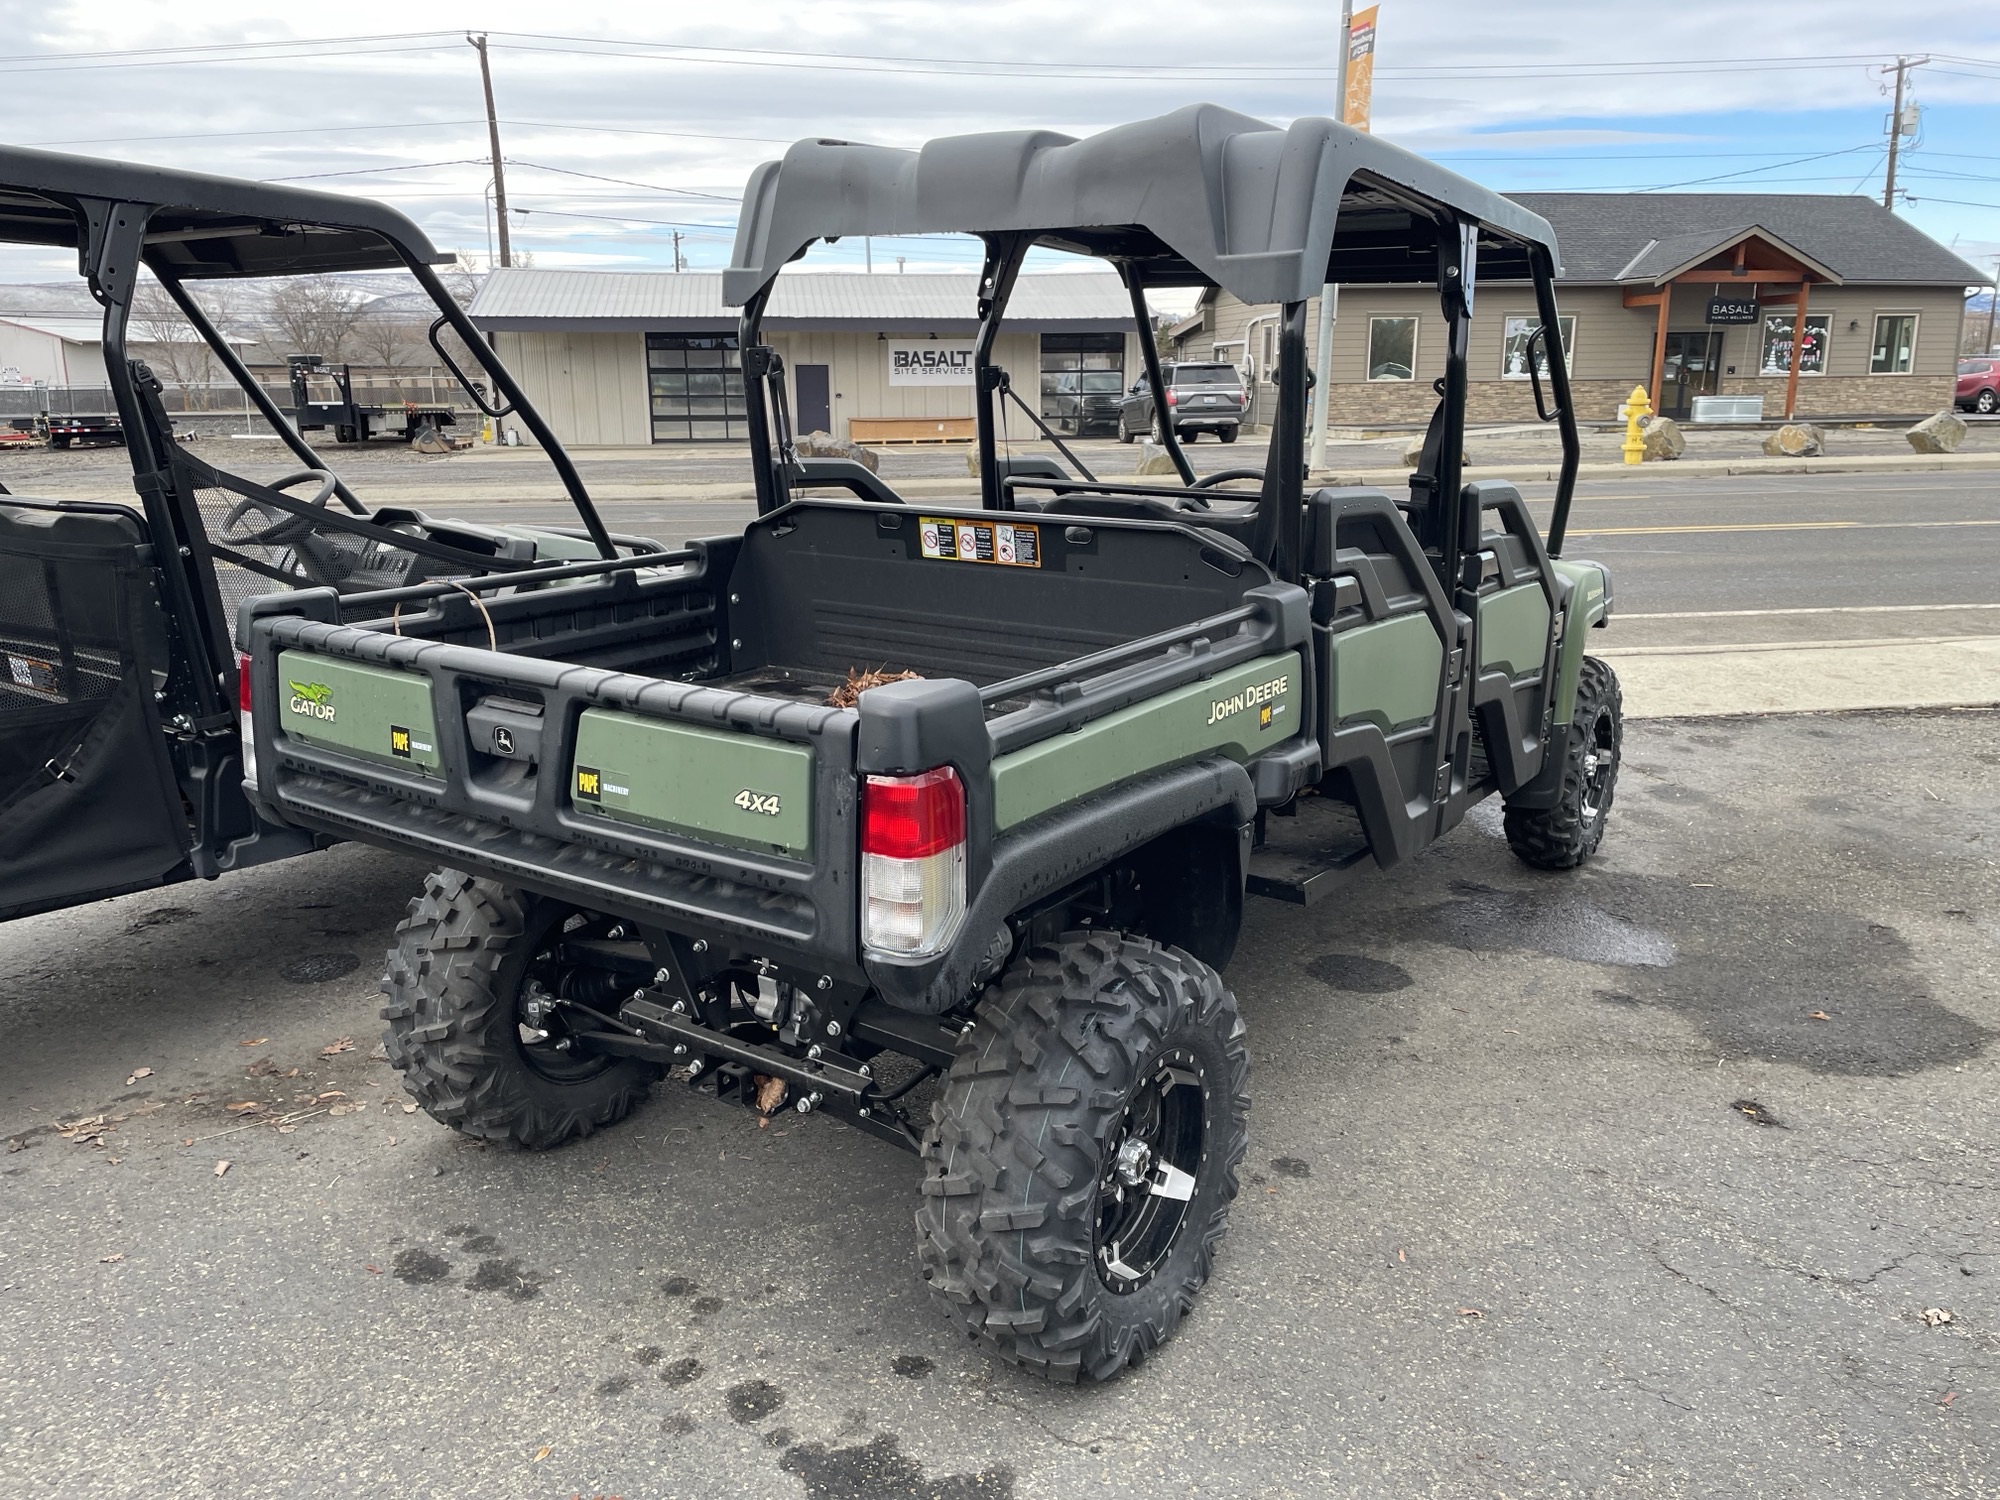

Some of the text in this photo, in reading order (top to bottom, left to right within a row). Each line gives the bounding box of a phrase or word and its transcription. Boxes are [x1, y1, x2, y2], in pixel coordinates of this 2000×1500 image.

[1712, 304, 1756, 314] BASALT
[894, 350, 973, 367] BASALT
[1207, 675, 1288, 725] JOHN DEERE
[290, 696, 336, 722] GATOR
[603, 783, 630, 796] MACHINERY
